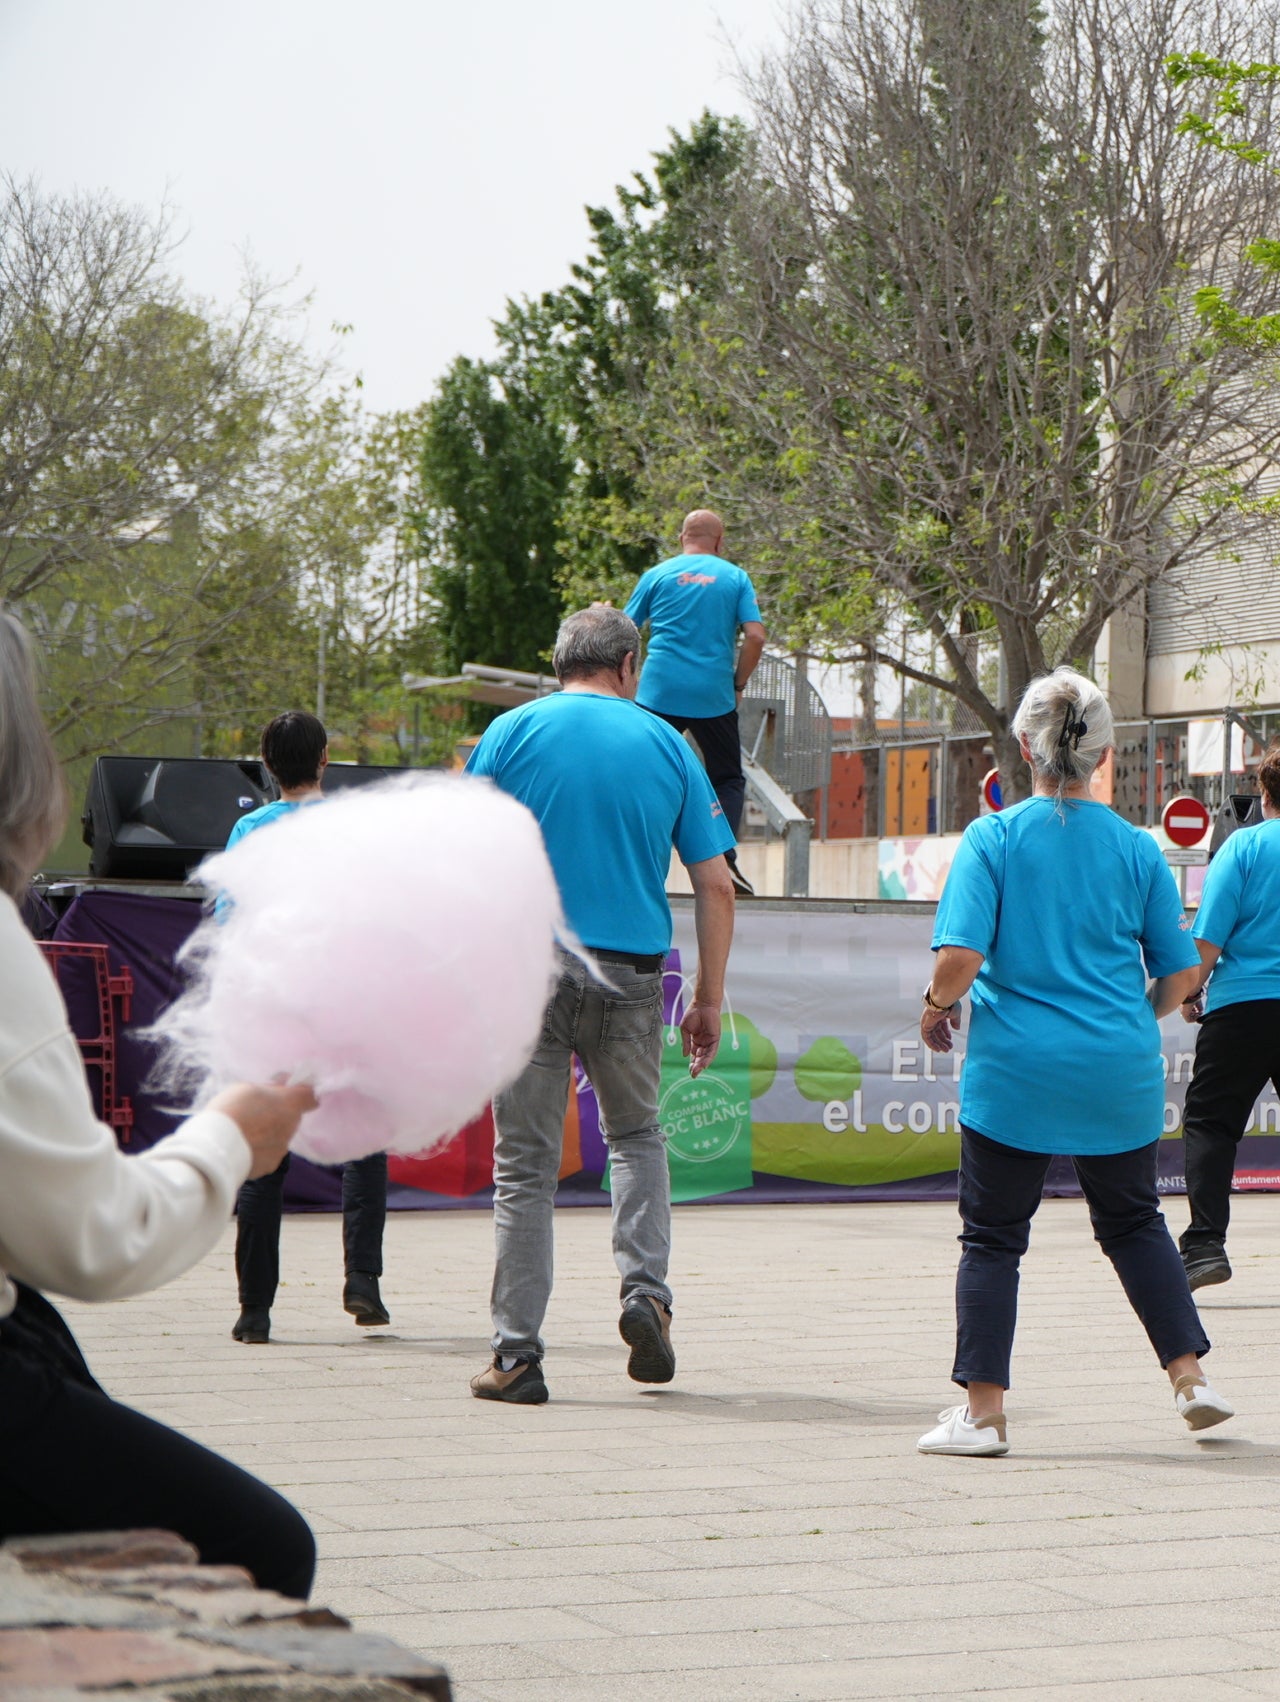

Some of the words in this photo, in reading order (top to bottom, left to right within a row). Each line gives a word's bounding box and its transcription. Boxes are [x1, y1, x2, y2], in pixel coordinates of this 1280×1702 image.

[892, 1040, 936, 1082] El
[662, 1119, 689, 1137] OC
[692, 1101, 748, 1129] BLANC
[823, 1090, 867, 1133] el
